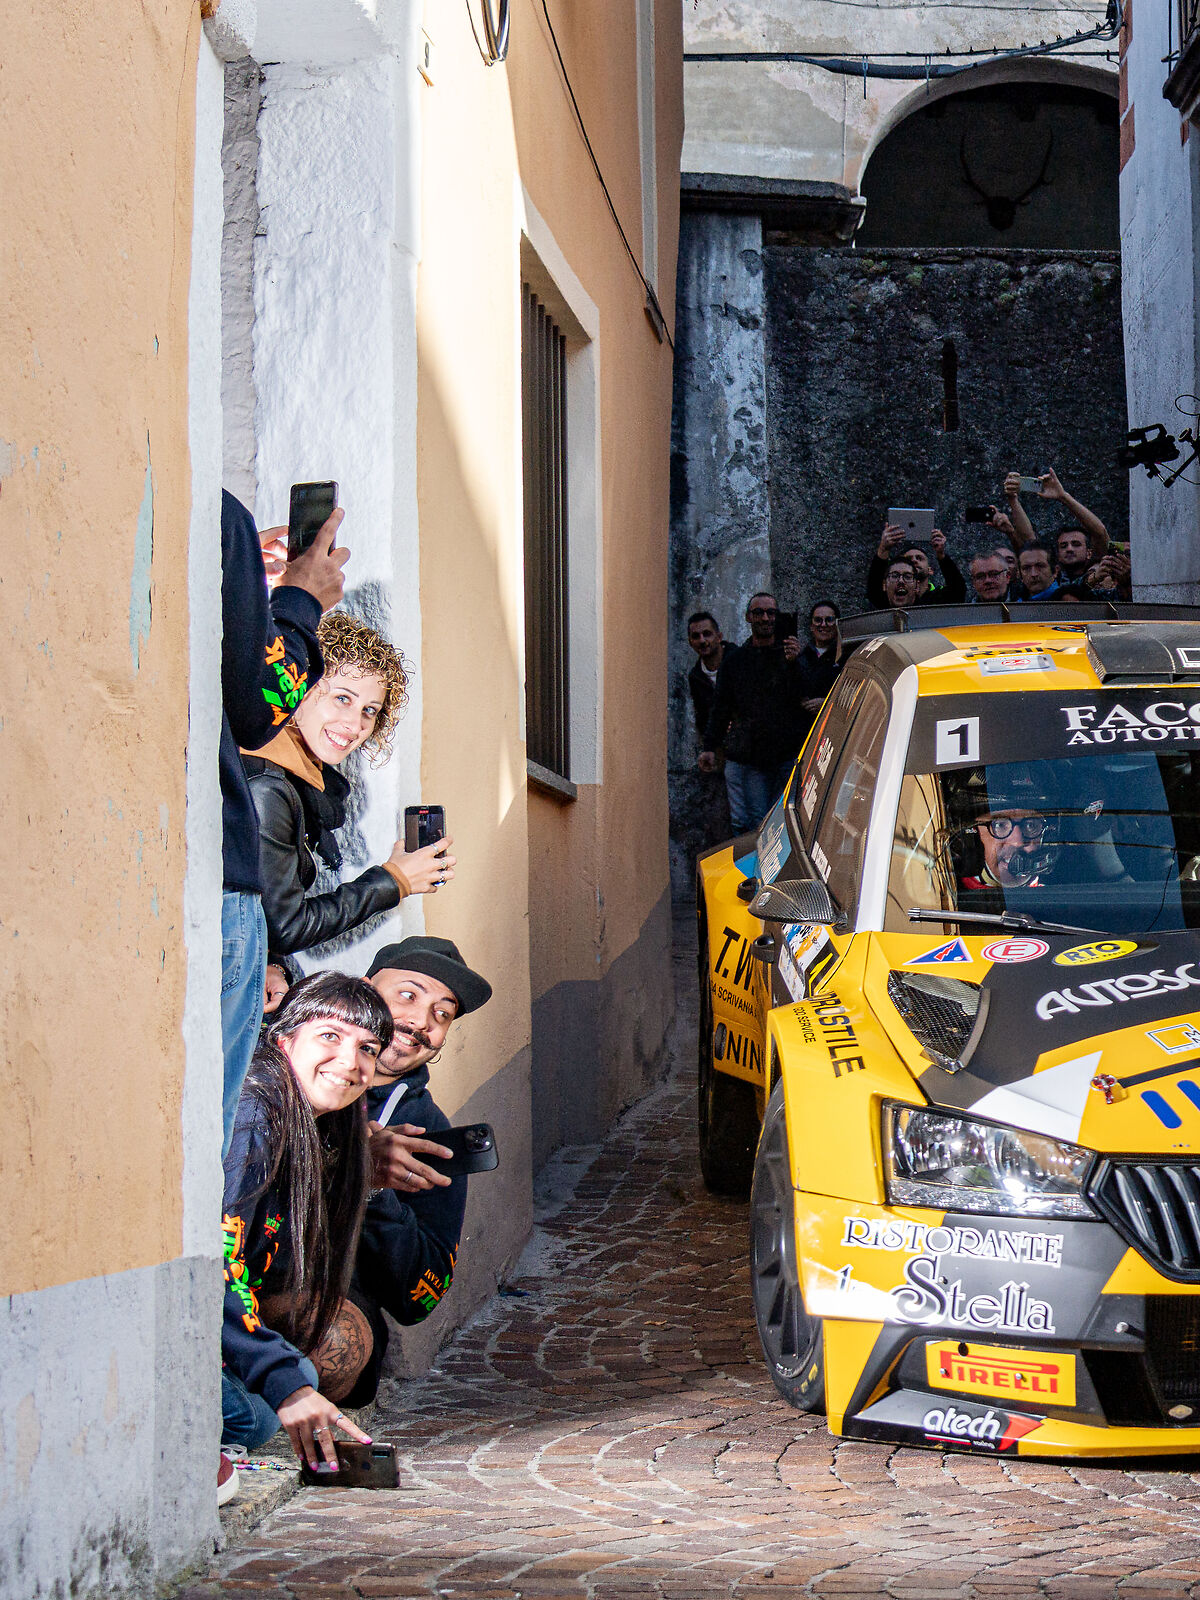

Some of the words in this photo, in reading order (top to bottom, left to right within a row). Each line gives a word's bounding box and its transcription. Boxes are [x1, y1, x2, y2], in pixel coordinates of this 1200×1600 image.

[951, 722, 971, 757] 1
[1063, 943, 1121, 961] RTO
[842, 1217, 1063, 1266] RISTORANTE
[890, 1254, 1056, 1333] Stella
[939, 1349, 1060, 1394] PIRELLI
[923, 1407, 1001, 1440] atech
